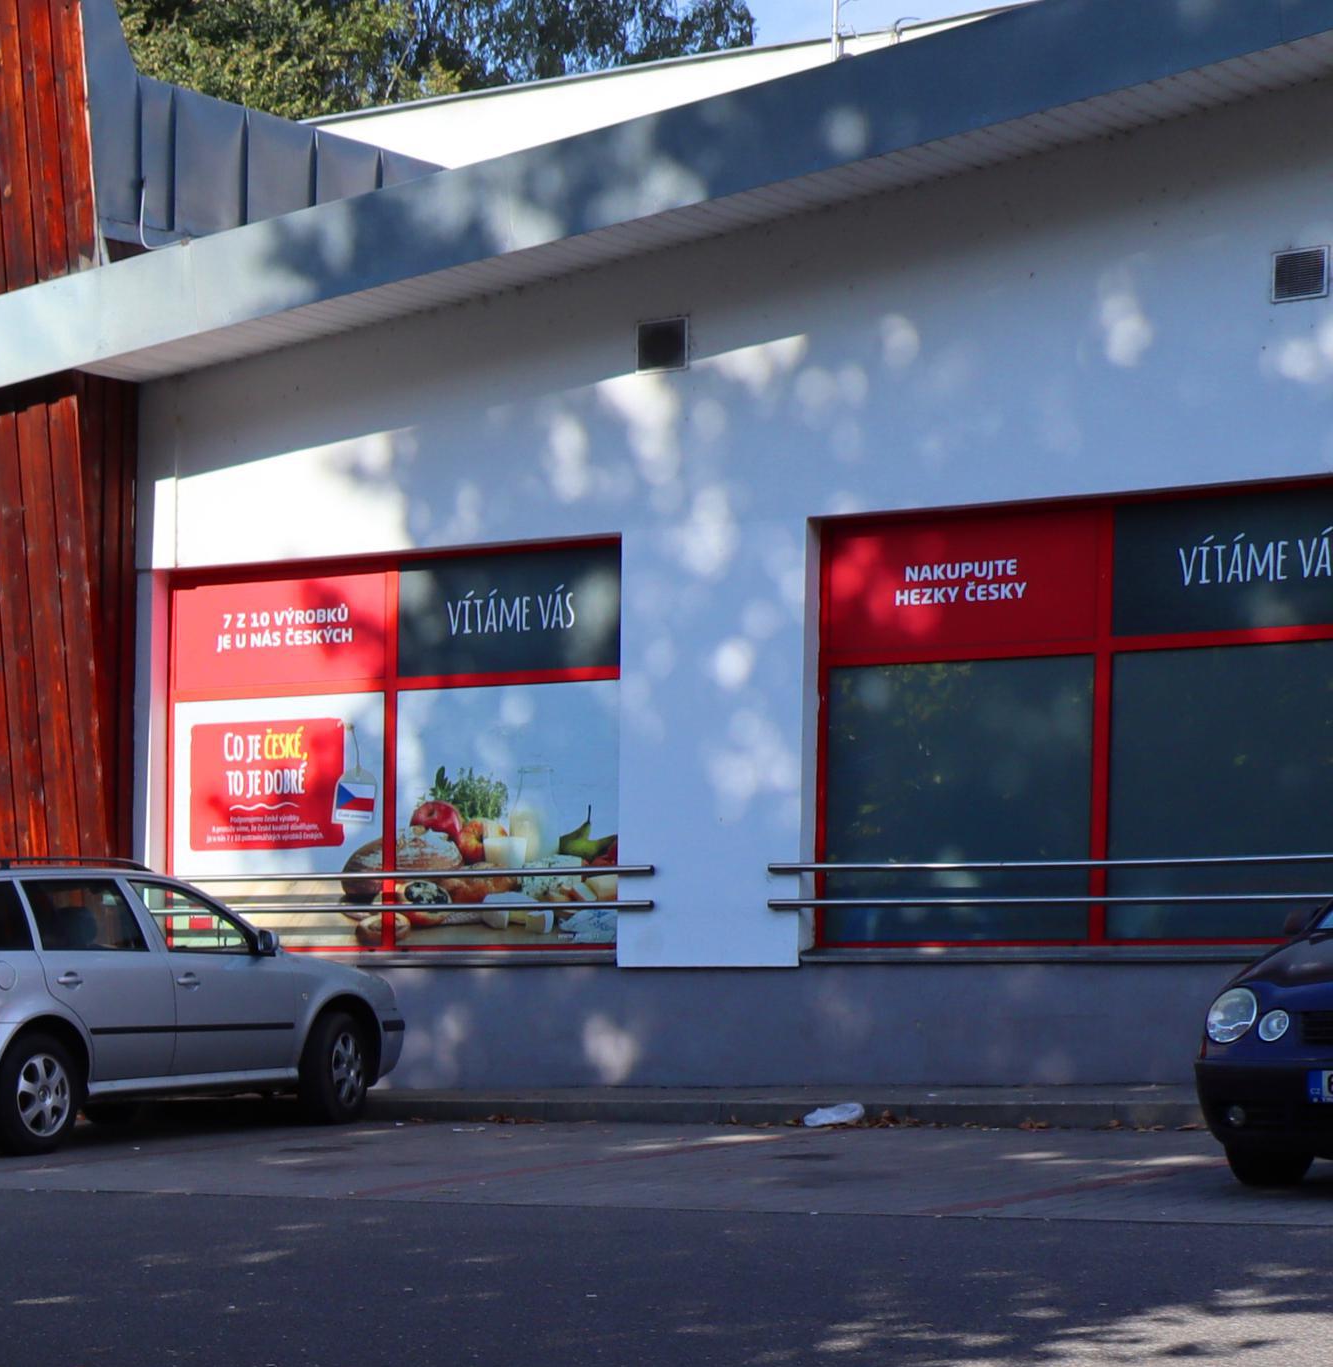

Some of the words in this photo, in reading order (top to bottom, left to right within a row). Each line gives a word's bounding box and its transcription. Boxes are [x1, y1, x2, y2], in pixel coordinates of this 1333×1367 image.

[905, 559, 1018, 582] NAKUPUJTE
[1179, 532, 1289, 587] VÍTÁME
[447, 588, 531, 636] VÍTÁME
[537, 584, 575, 630] VÁS
[895, 586, 959, 606] HEZKY
[965, 581, 1027, 602] ČESKY
[223, 614, 232, 629] 7
[236, 613, 246, 629] Z
[250, 612, 270, 628] 10
[273, 603, 349, 627] VÝROBKŮ
[216, 634, 232, 653] JE
[235, 633, 246, 649] U
[250, 629, 281, 648] NÁS
[285, 625, 353, 646] ČESKÝCH
[246, 734, 262, 763] JE
[264, 725, 308, 760] ČESKÉ,
[226, 770, 244, 796] TO
[246, 770, 262, 799] JE
[264, 761, 308, 795] DOBRÉ
